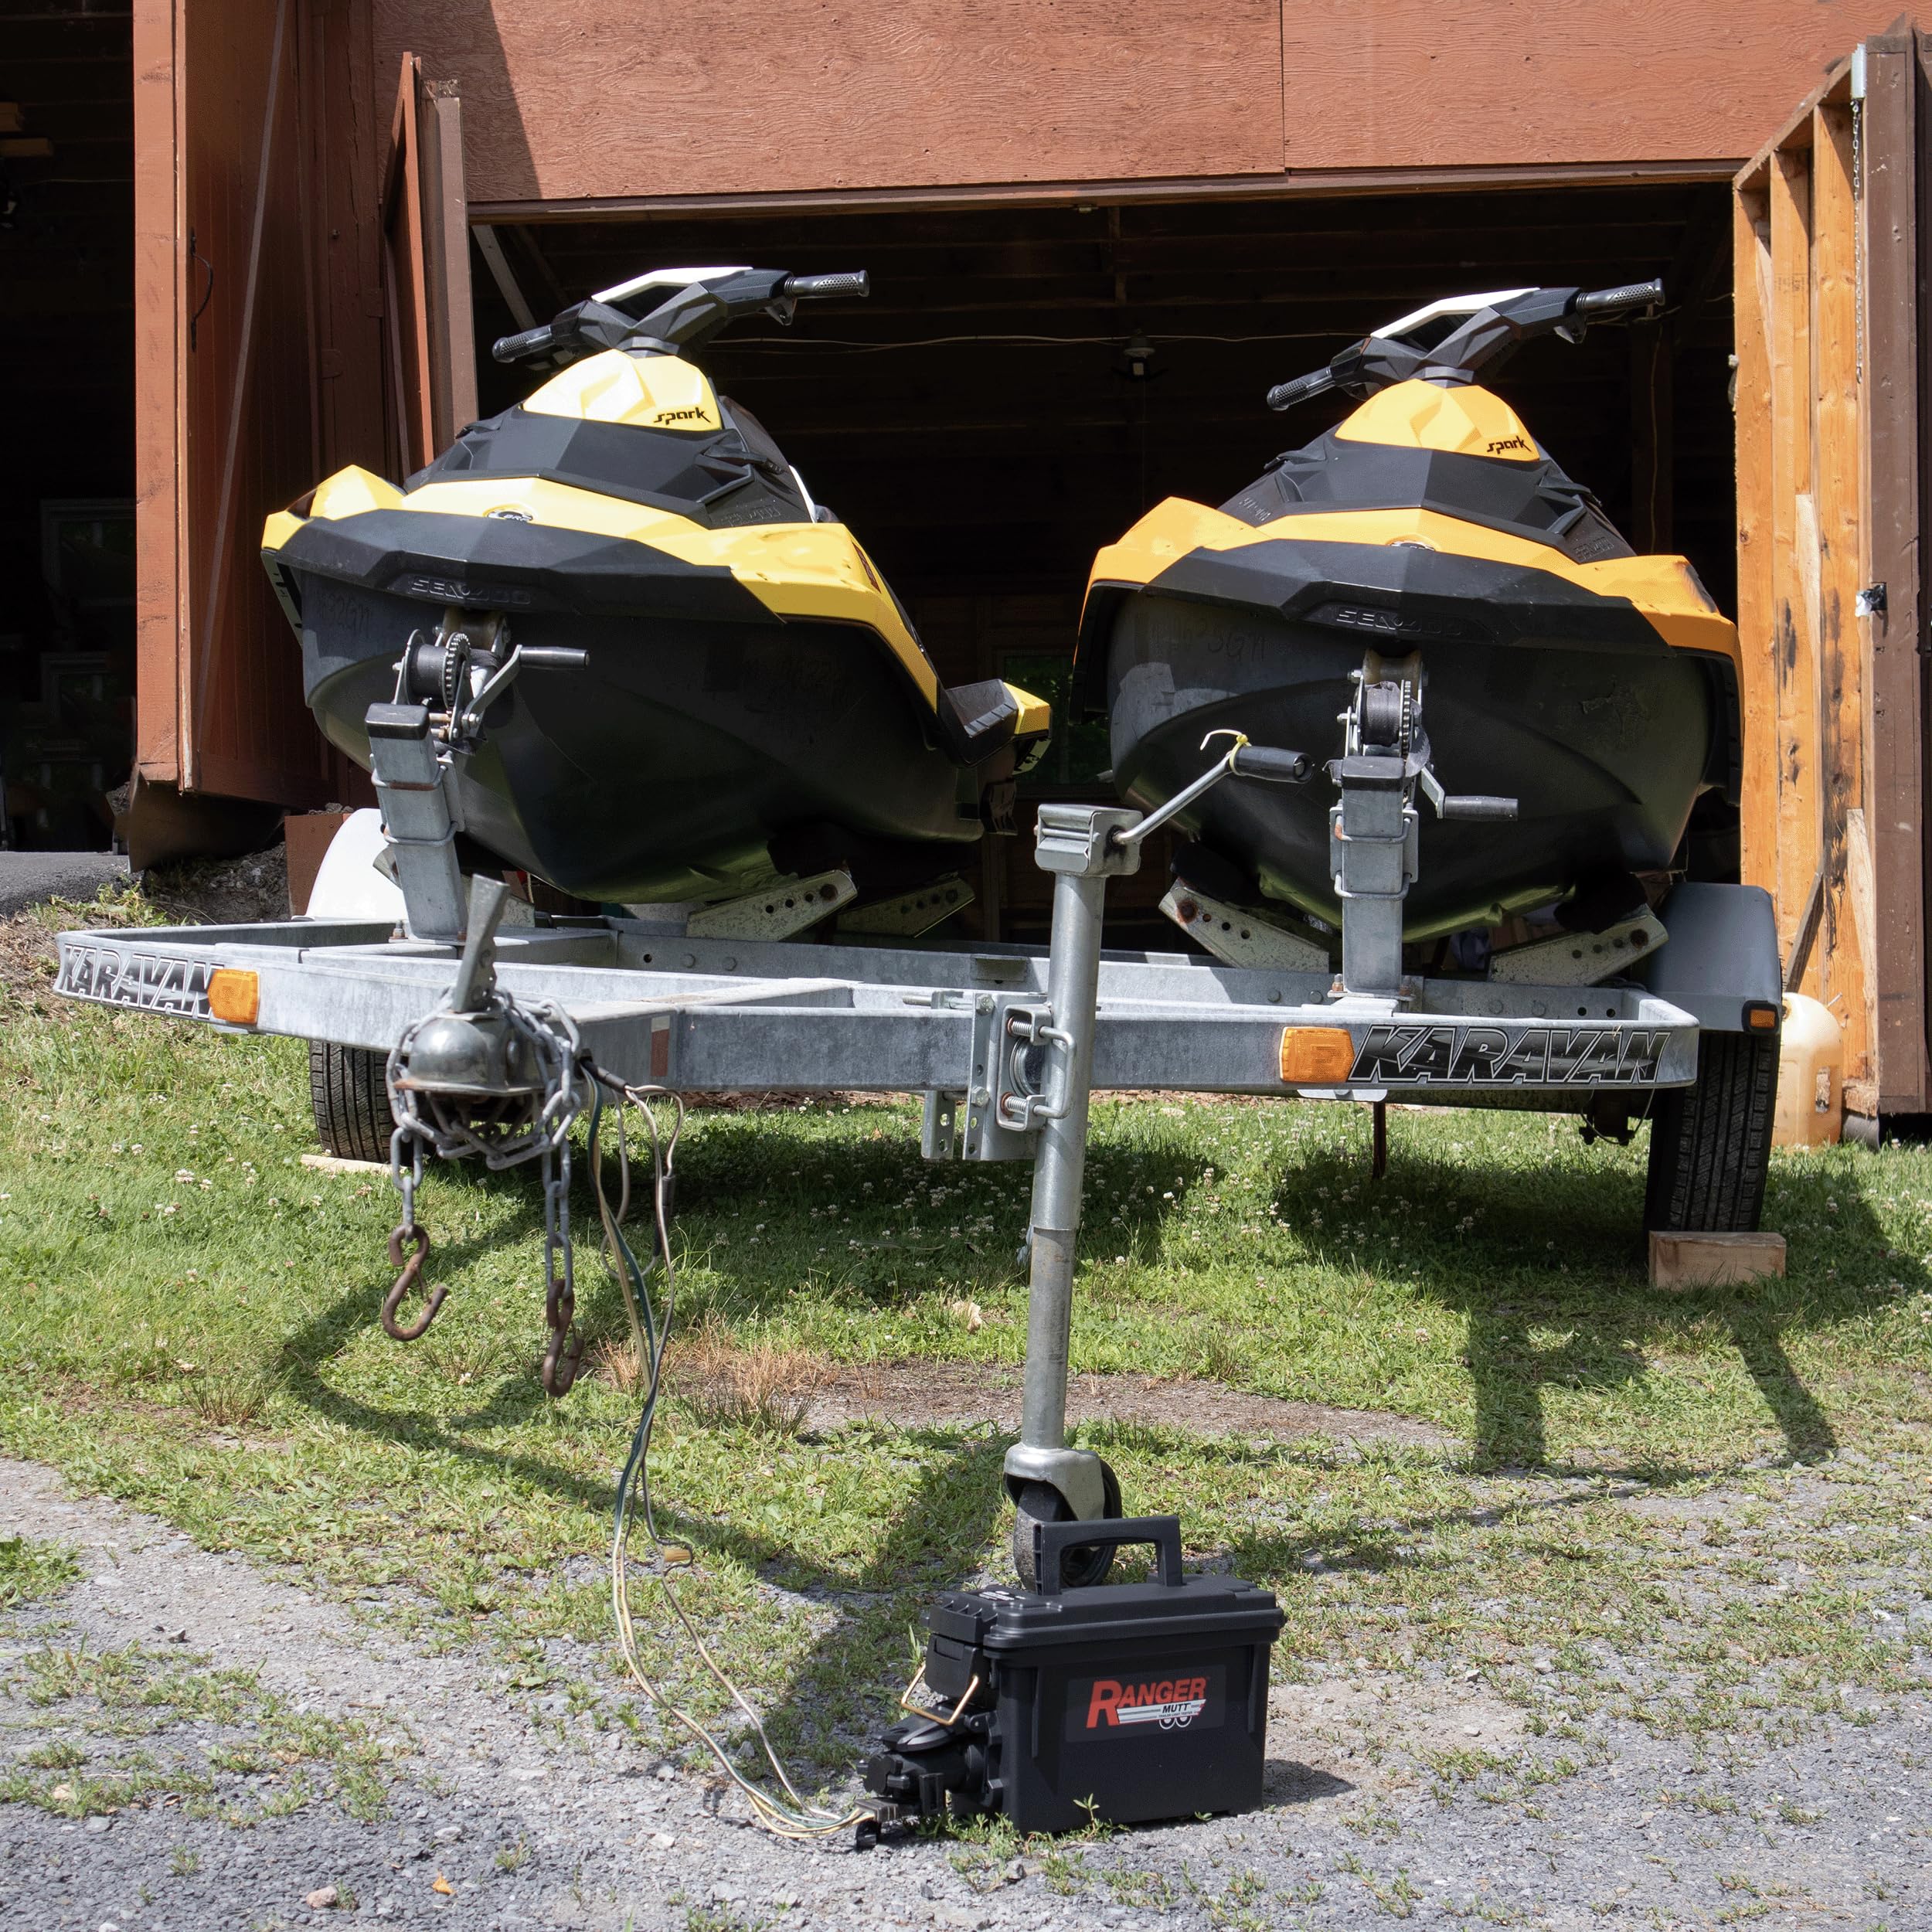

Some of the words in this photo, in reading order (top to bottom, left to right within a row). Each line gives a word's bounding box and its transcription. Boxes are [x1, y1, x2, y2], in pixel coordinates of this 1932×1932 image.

[653, 406, 711, 425] spark
[1487, 435, 1532, 454] spark
[1348, 1025, 1671, 1083] KARAVAN
[1087, 1677, 1206, 1728] RANGER
[1162, 1702, 1191, 1713] MUTT
